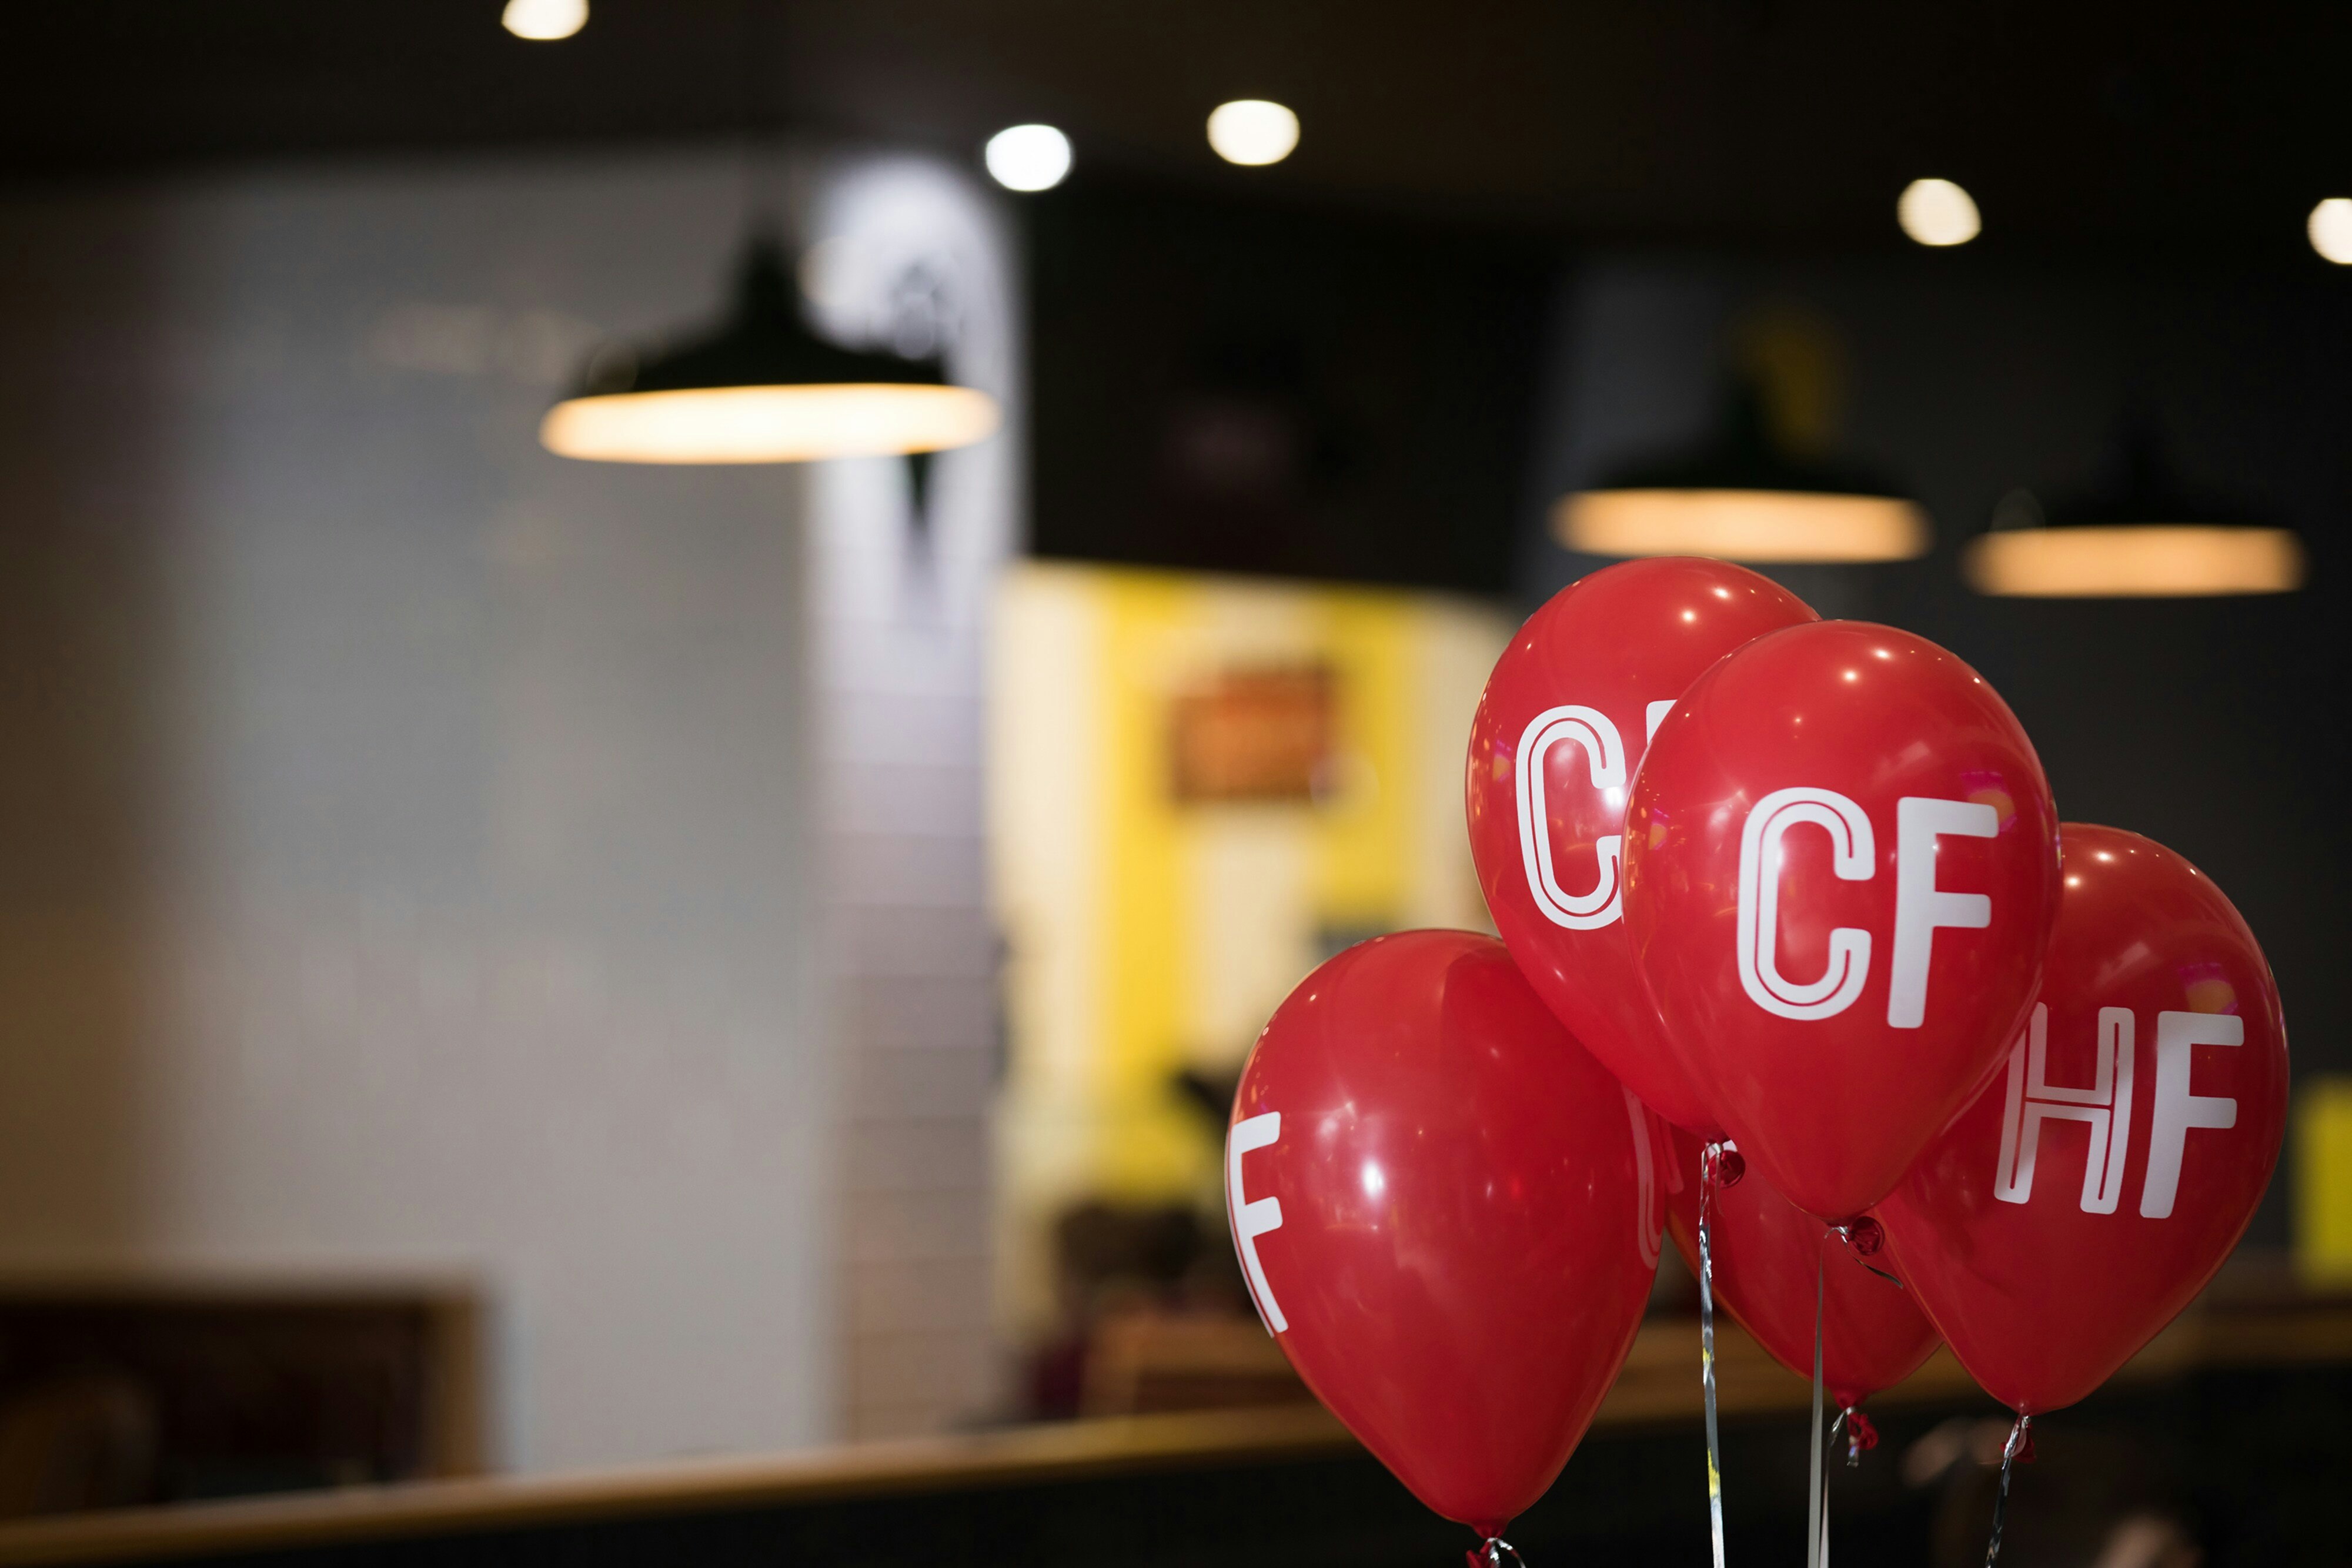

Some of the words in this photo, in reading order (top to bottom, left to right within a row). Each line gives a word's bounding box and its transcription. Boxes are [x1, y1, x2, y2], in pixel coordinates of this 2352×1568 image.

[1515, 699, 1678, 931] C
[1736, 787, 1999, 1029] CF
[1993, 1001, 2244, 1219] HF
